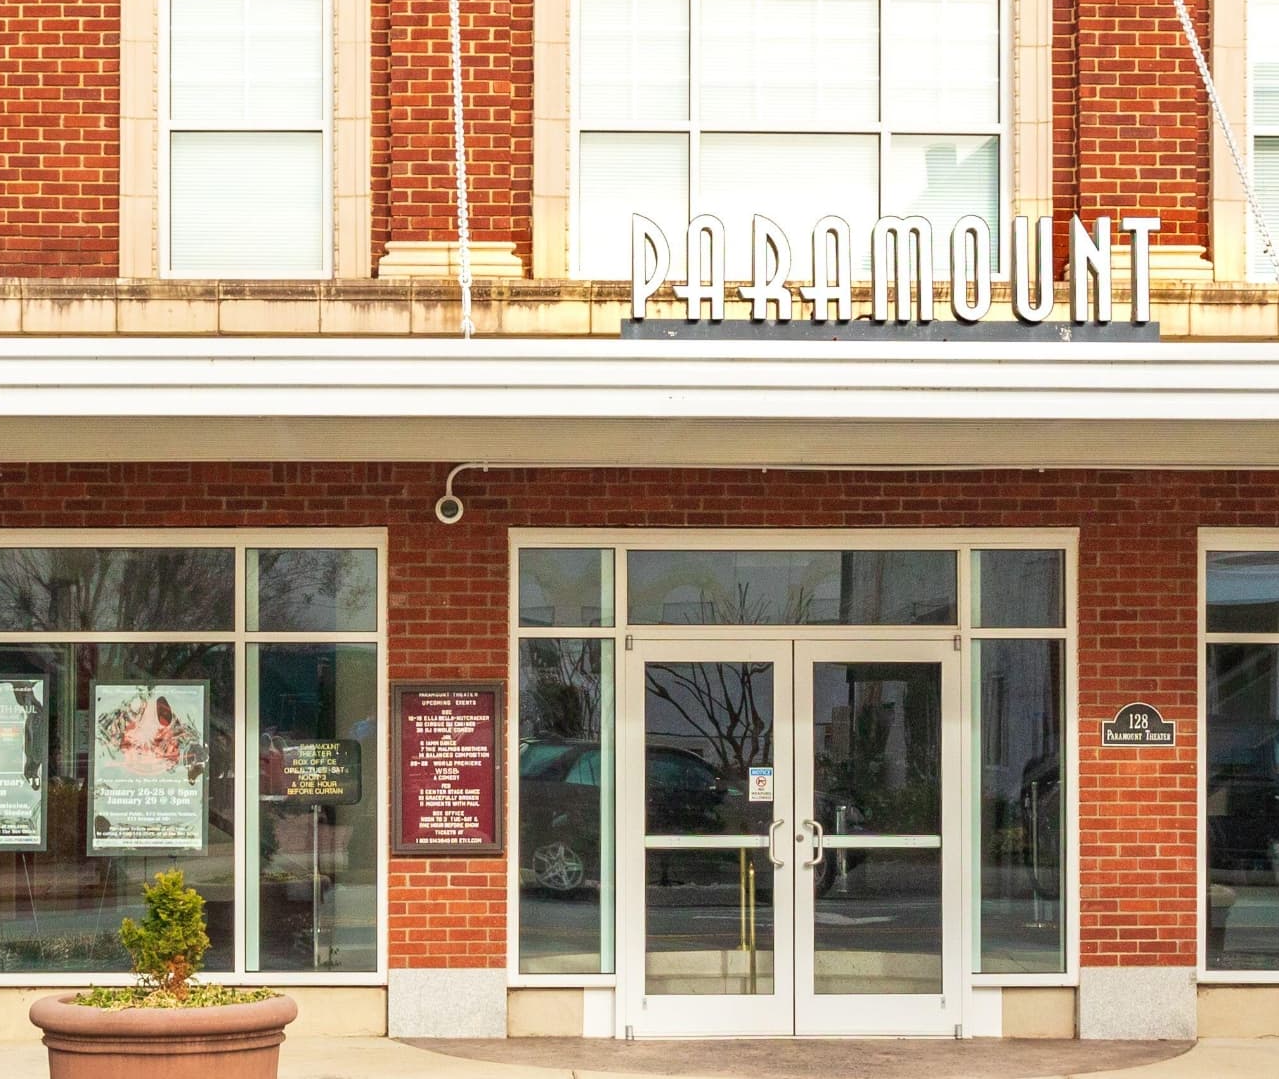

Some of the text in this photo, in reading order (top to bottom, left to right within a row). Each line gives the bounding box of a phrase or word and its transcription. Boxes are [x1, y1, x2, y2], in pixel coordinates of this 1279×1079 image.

[632, 213, 1161, 321] PARAMOUNT
[1129, 714, 1148, 729] 128
[100, 788, 135, 796] January
[107, 797, 141, 806] January
[170, 797, 190, 806] 3pm
